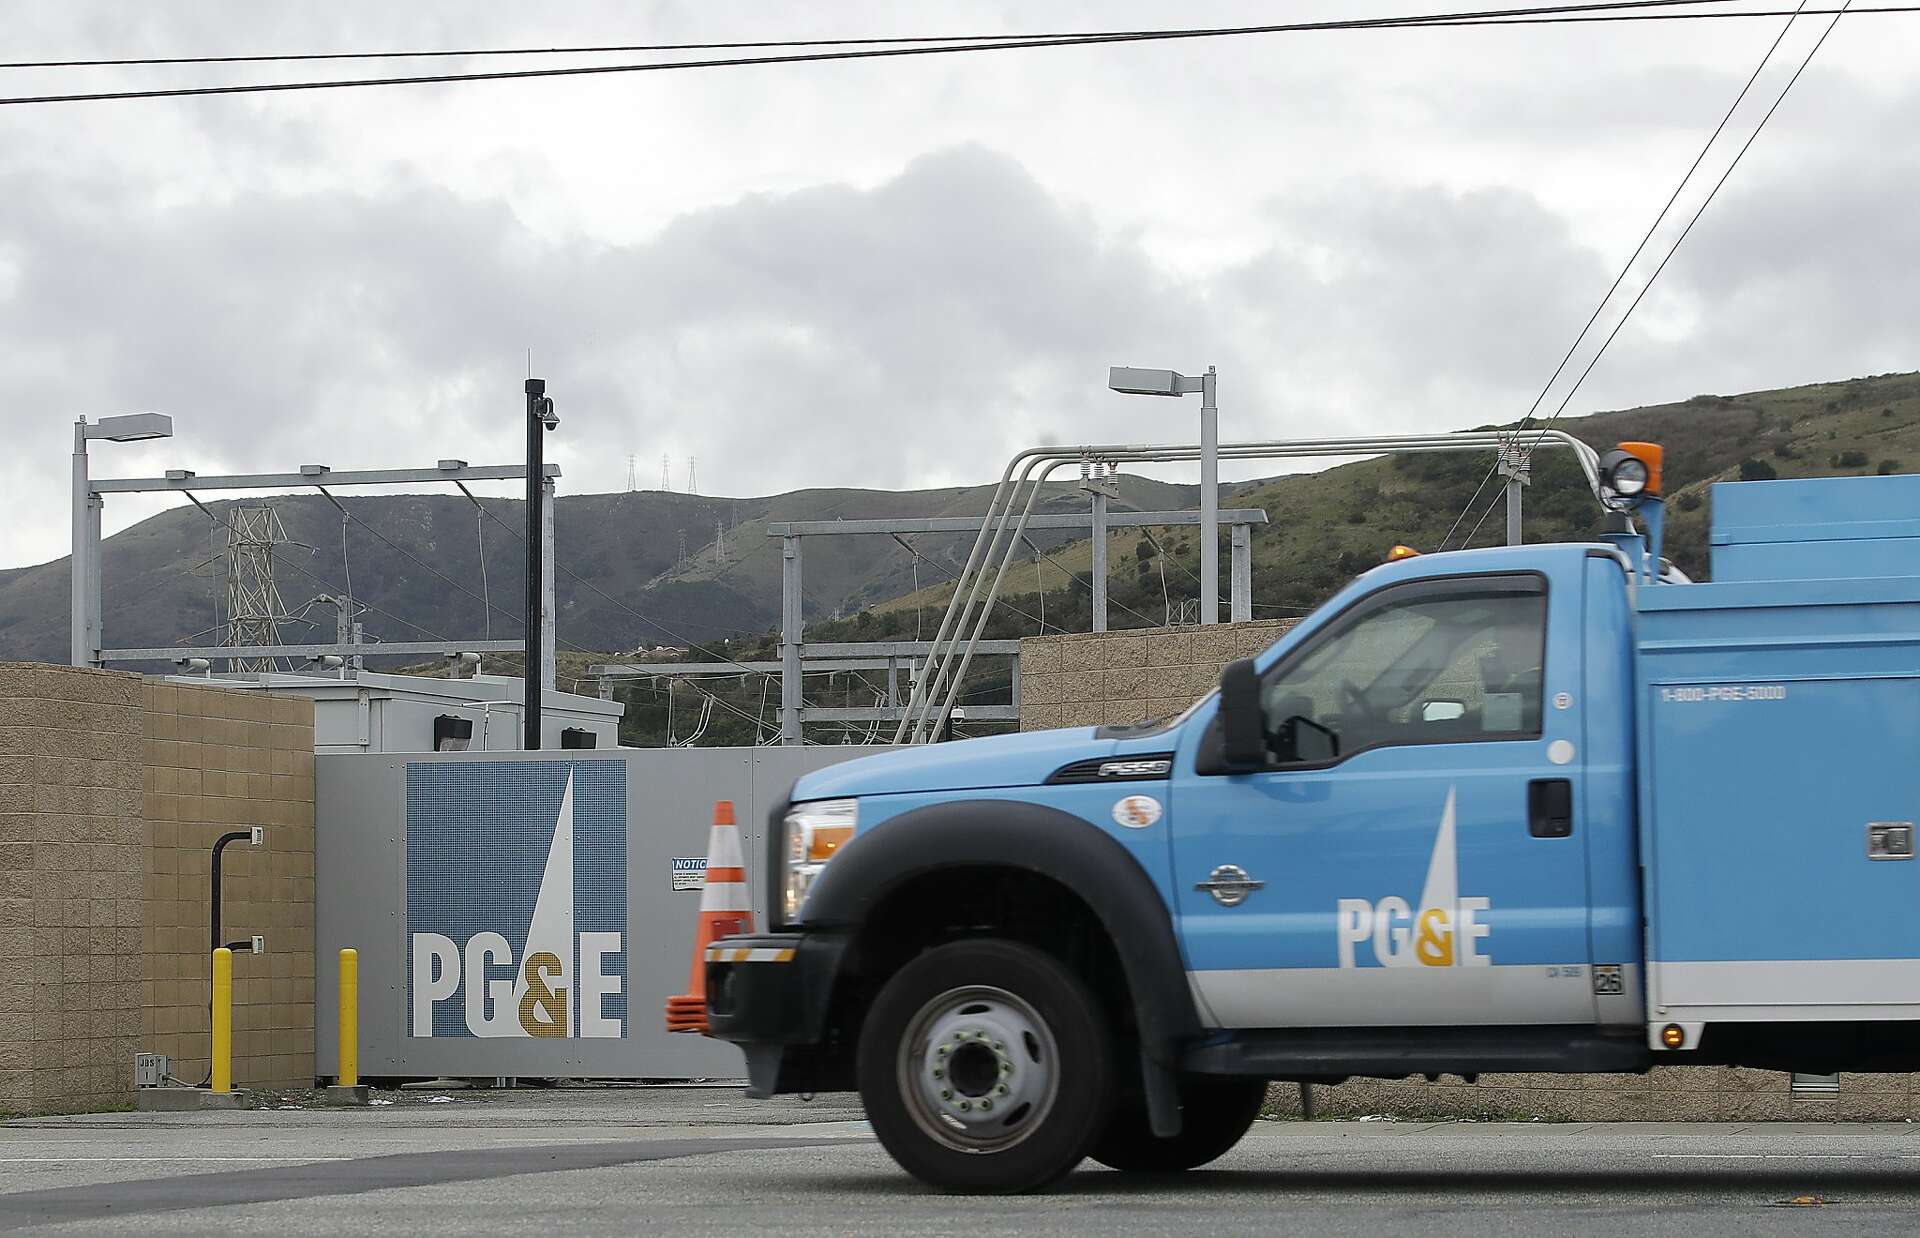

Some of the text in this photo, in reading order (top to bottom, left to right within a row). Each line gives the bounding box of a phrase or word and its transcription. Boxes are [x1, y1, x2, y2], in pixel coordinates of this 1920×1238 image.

[675, 860, 707, 869] NOTIC
[1337, 896, 1490, 968] PG&E
[412, 931, 622, 1038] PG&E
